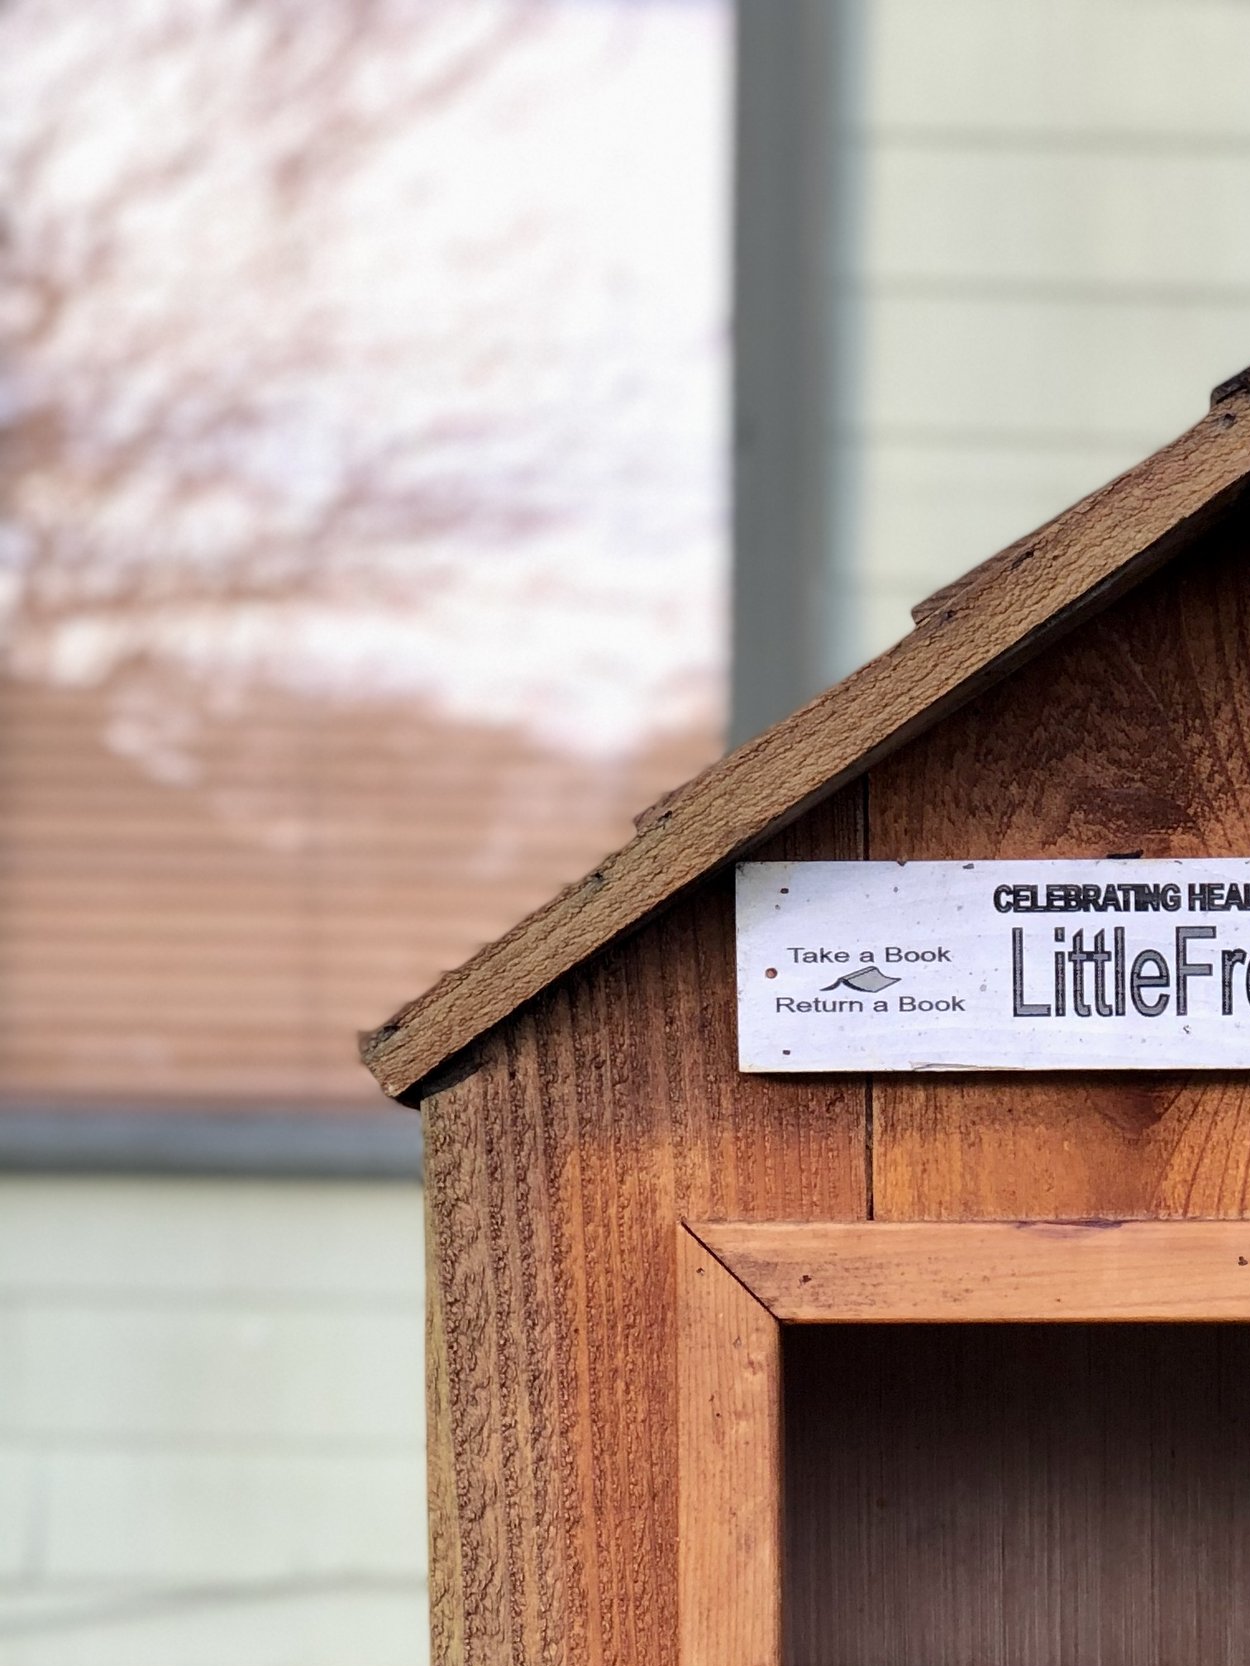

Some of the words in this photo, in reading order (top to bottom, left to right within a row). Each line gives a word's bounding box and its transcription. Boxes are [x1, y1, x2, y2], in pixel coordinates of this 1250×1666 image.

[993, 883, 1181, 913] CELEBRATING
[787, 946, 850, 965] Take
[859, 951, 875, 964] a
[884, 945, 952, 964] Book
[775, 996, 864, 1013] Return
[873, 1000, 889, 1013] a
[899, 995, 966, 1013] Book
